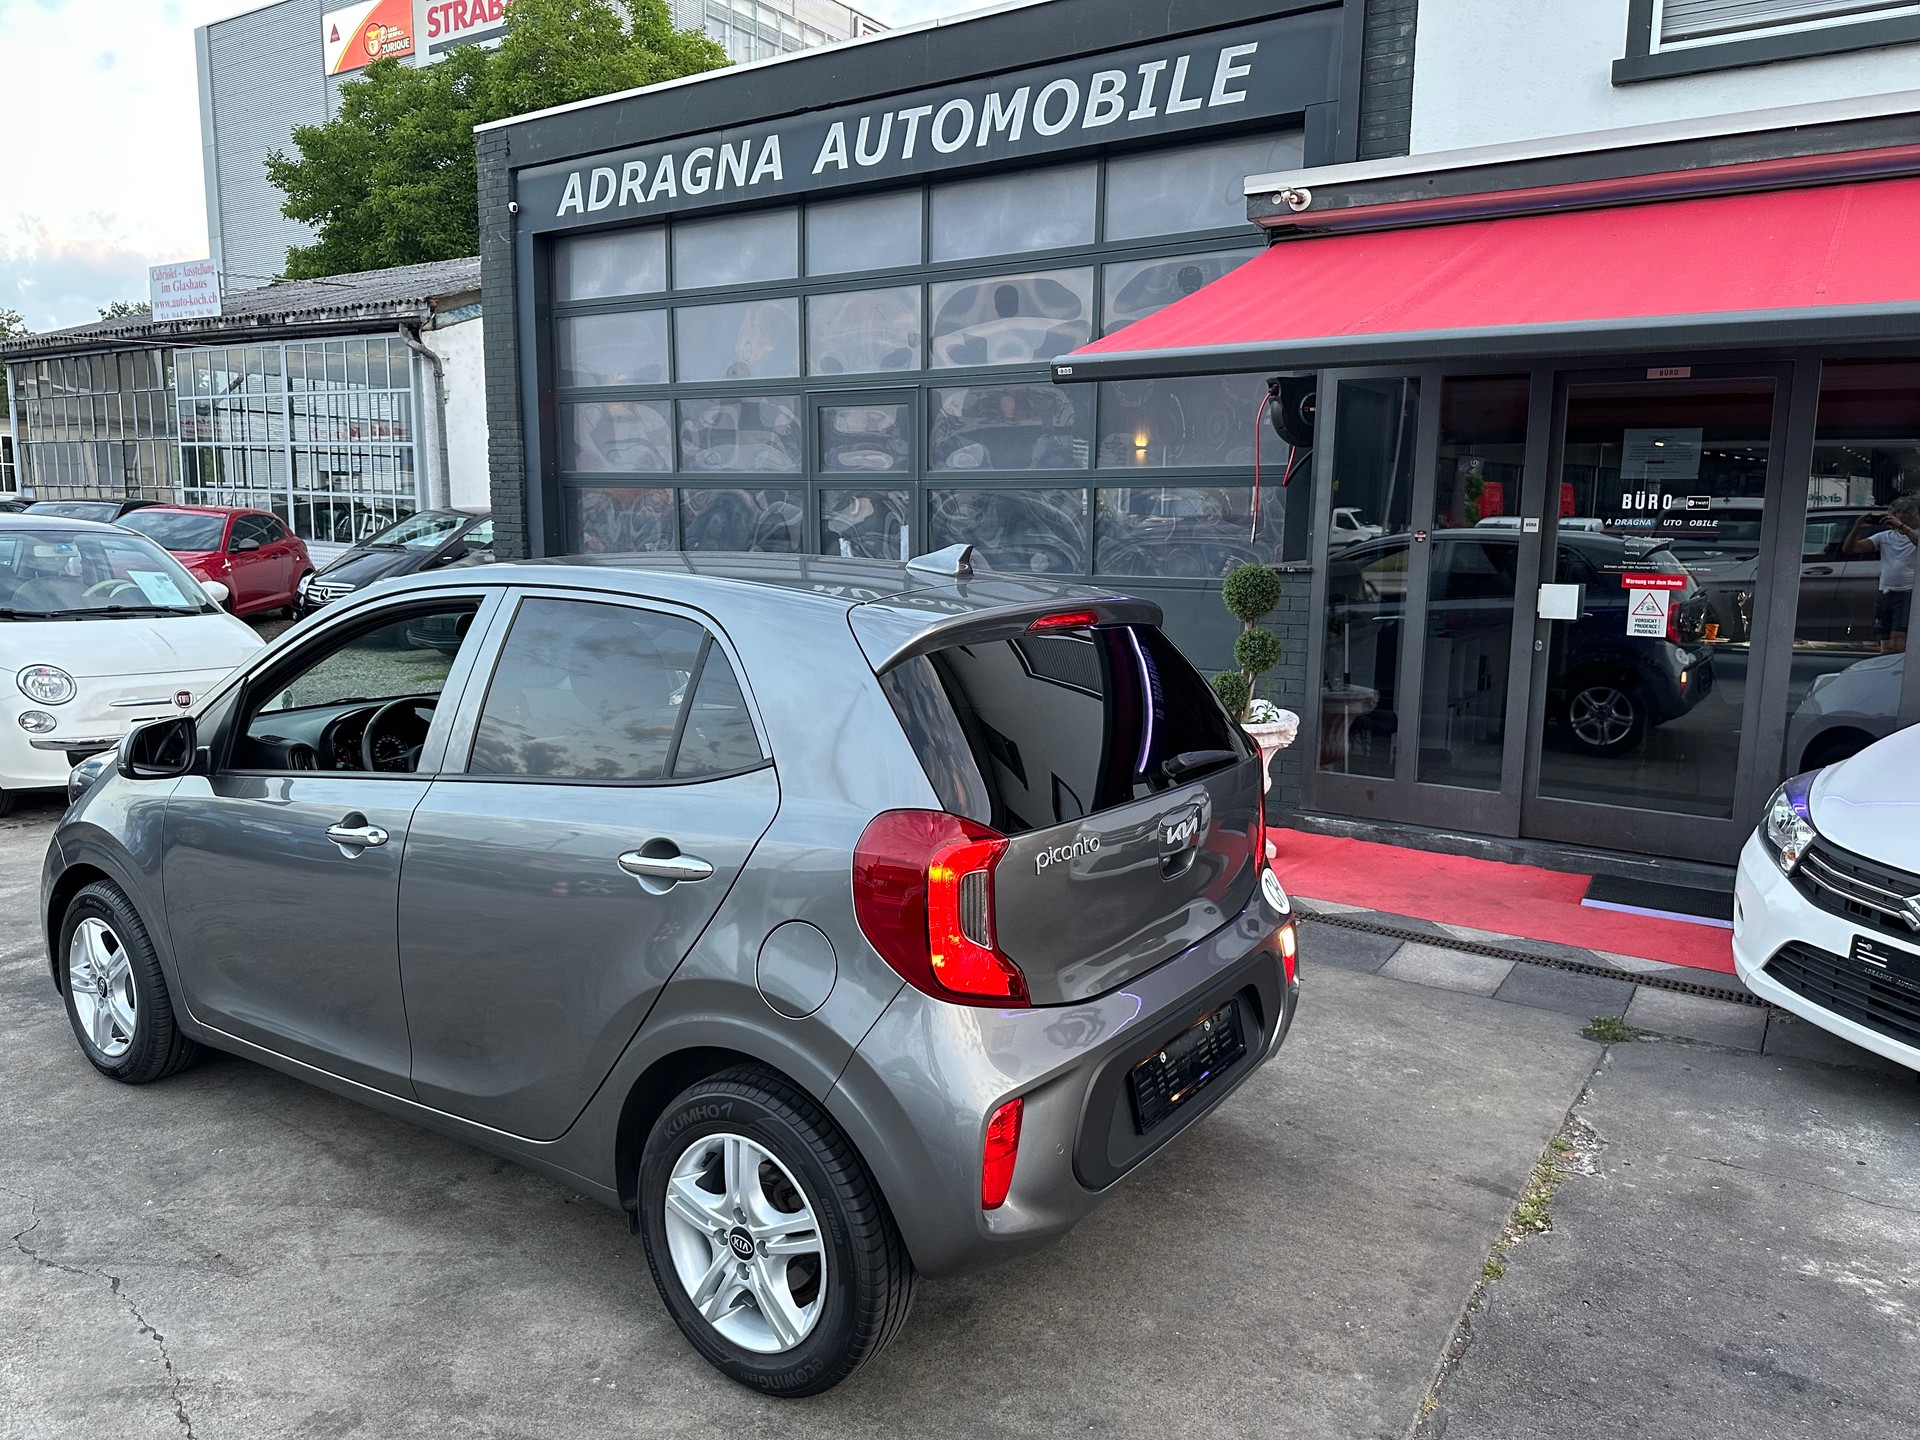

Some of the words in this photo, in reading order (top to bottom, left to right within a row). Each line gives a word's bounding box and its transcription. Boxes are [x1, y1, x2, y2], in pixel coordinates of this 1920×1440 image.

[427, 0, 508, 38] STRAB
[381, 37, 410, 55] ZURIQUE
[556, 134, 784, 217] ADRAGNA
[811, 41, 1259, 175] AUTOMOBILE
[183, 263, 215, 277] Ausstellung
[161, 282, 171, 293] im
[172, 278, 208, 292] Glashaus
[154, 292, 218, 309] www.auto-koch.ch
[1659, 368, 1679, 377] BÜRO
[1622, 491, 1673, 510] BÜRO
[1625, 578, 1647, 586] Warnung
[1656, 578, 1667, 586] dem
[1034, 836, 1101, 876] picanto
[663, 1103, 720, 1140] KUMHO
[733, 1236, 749, 1252] KIA
